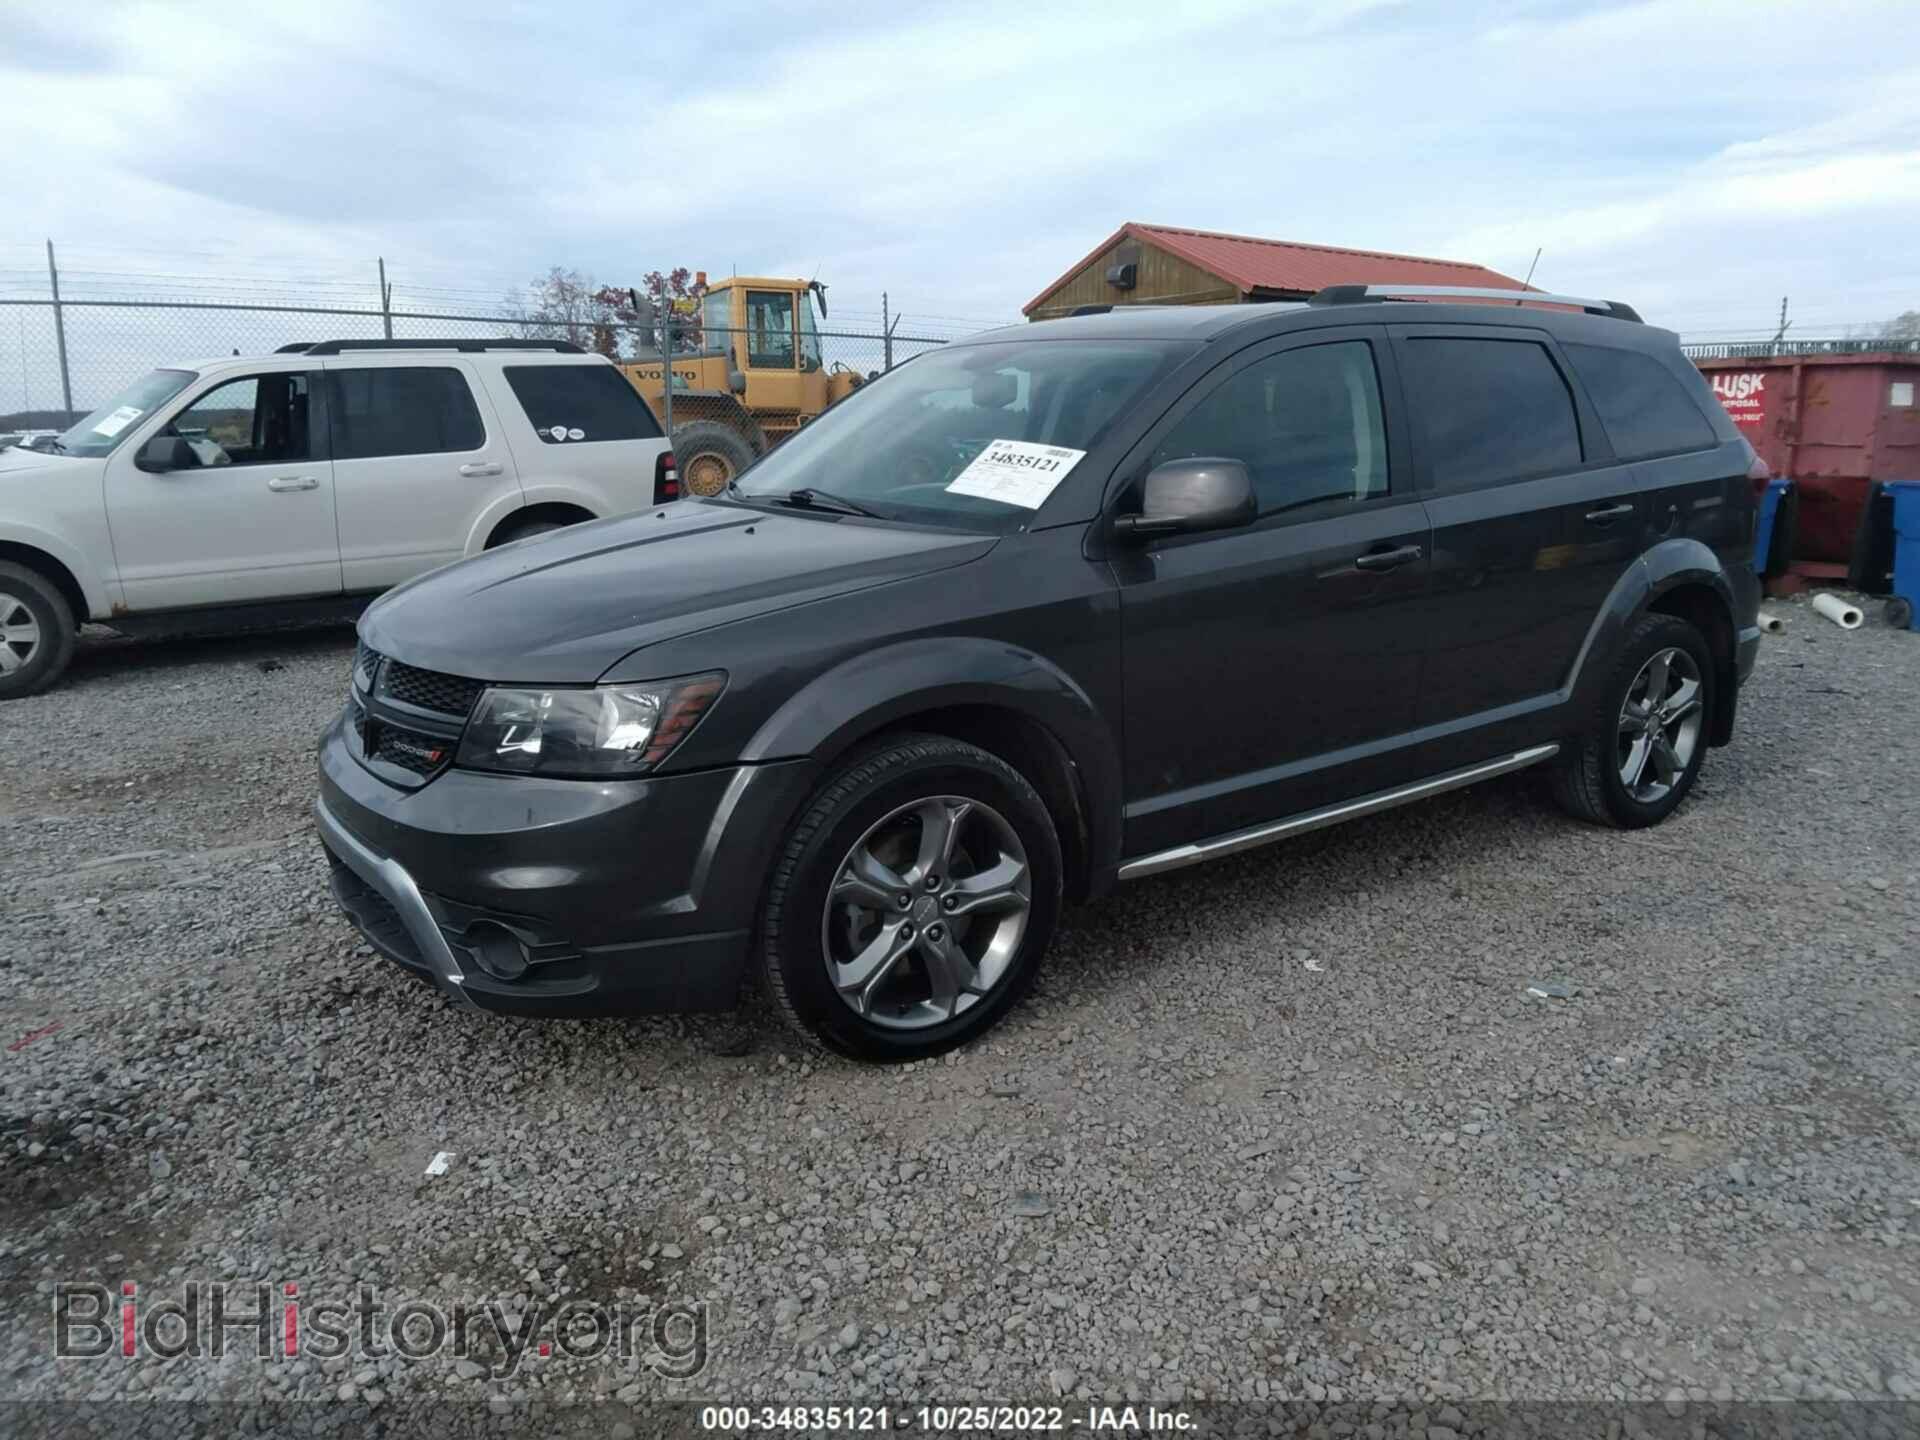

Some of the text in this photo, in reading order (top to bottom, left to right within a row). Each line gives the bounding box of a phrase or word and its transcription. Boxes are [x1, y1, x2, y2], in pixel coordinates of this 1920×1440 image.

[636, 370, 696, 379] VOVO
[1713, 374, 1765, 399] LUSK
[984, 451, 1060, 472] 34835121
